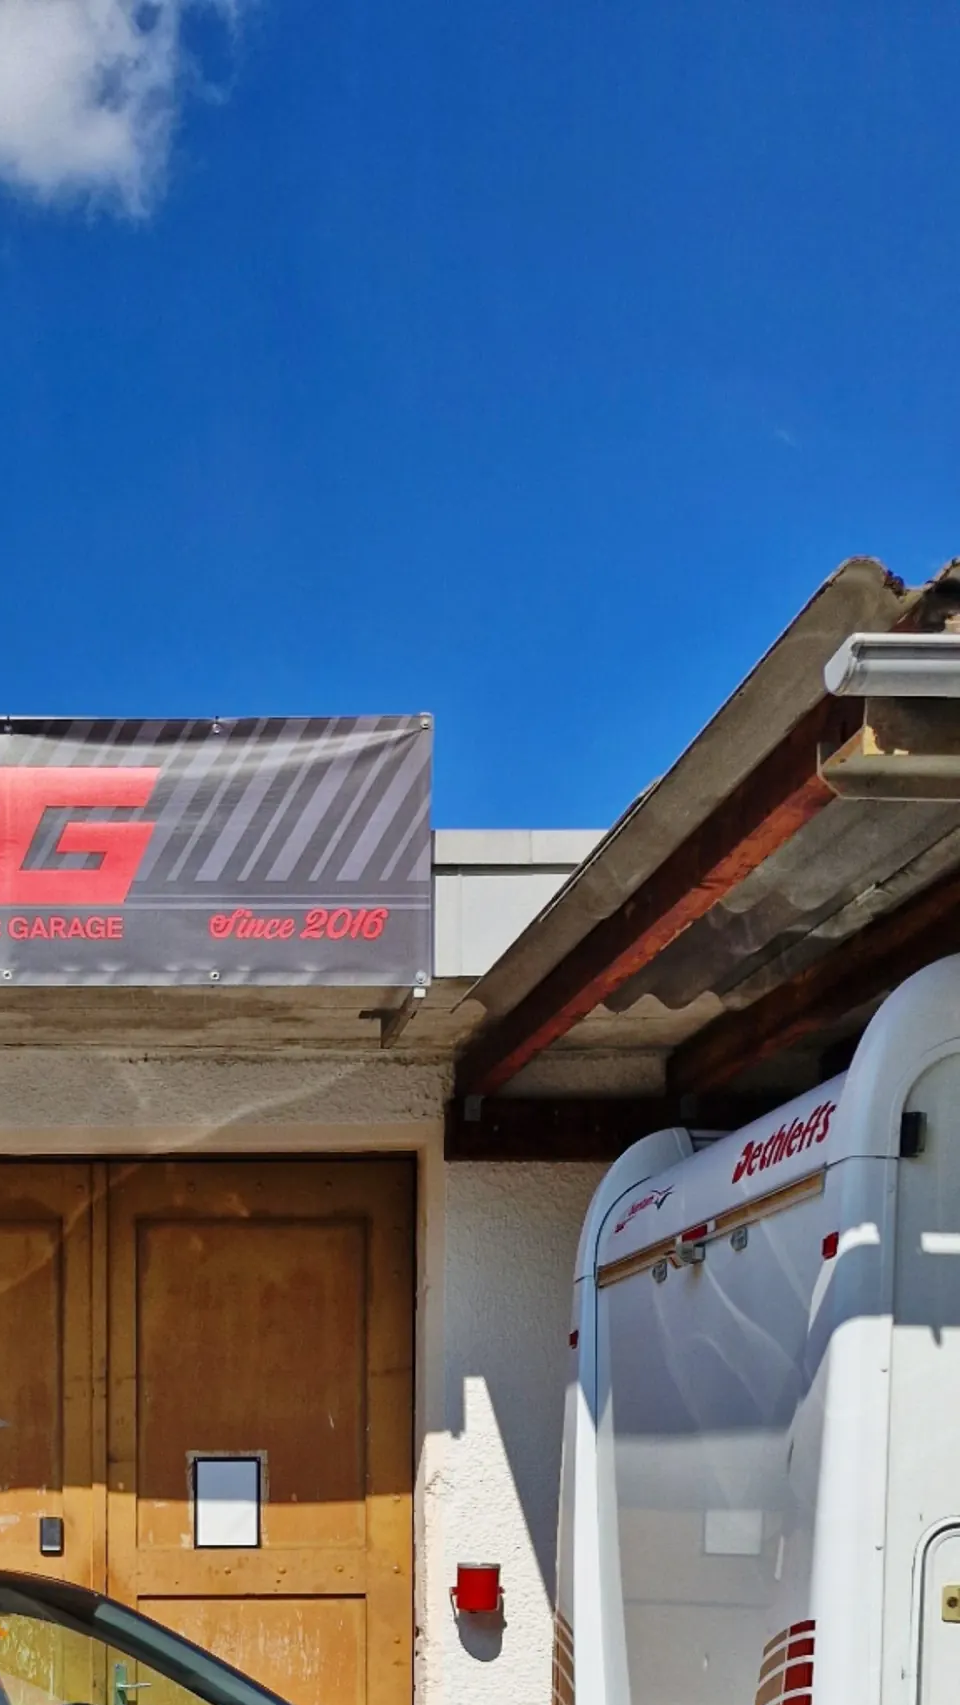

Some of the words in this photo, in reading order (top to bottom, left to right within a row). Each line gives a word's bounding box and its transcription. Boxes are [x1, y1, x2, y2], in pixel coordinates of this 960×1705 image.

[7, 916, 124, 941] GARAGE
[209, 907, 295, 940] Since
[299, 907, 389, 941] 2016
